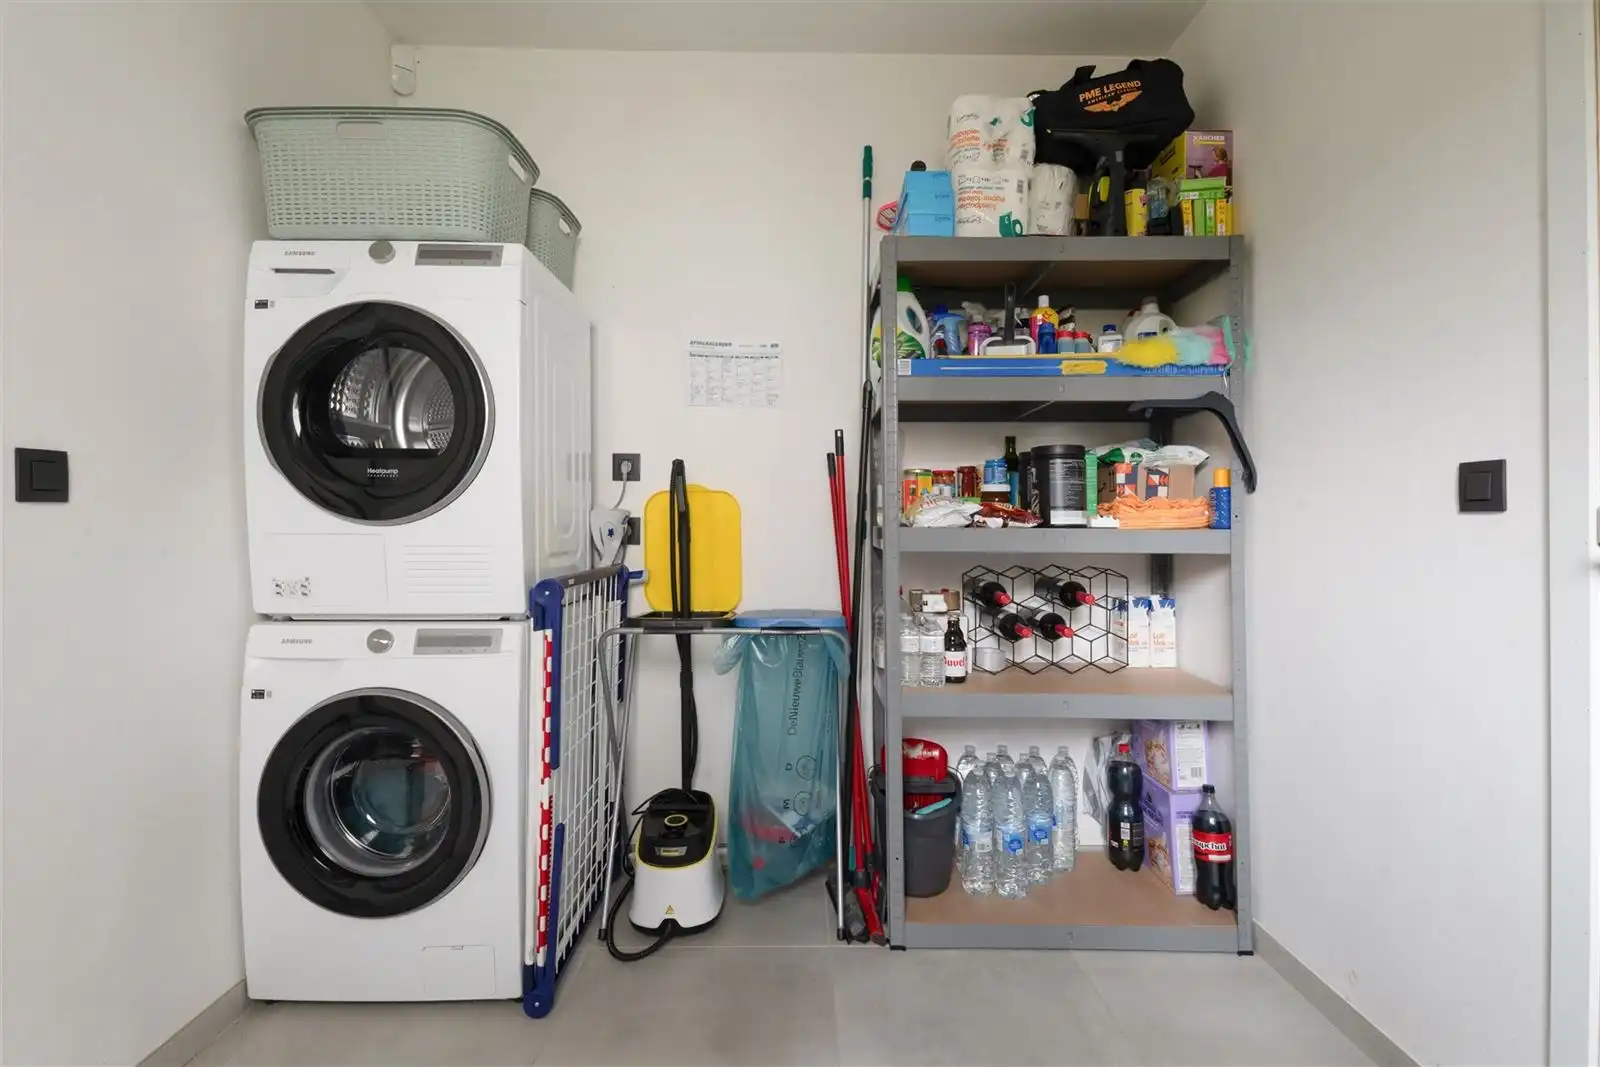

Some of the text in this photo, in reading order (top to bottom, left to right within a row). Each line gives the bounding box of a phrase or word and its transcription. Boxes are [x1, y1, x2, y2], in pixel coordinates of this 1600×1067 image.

[1079, 80, 1141, 102] PME LEGEND
[367, 467, 399, 475] Heatpump
